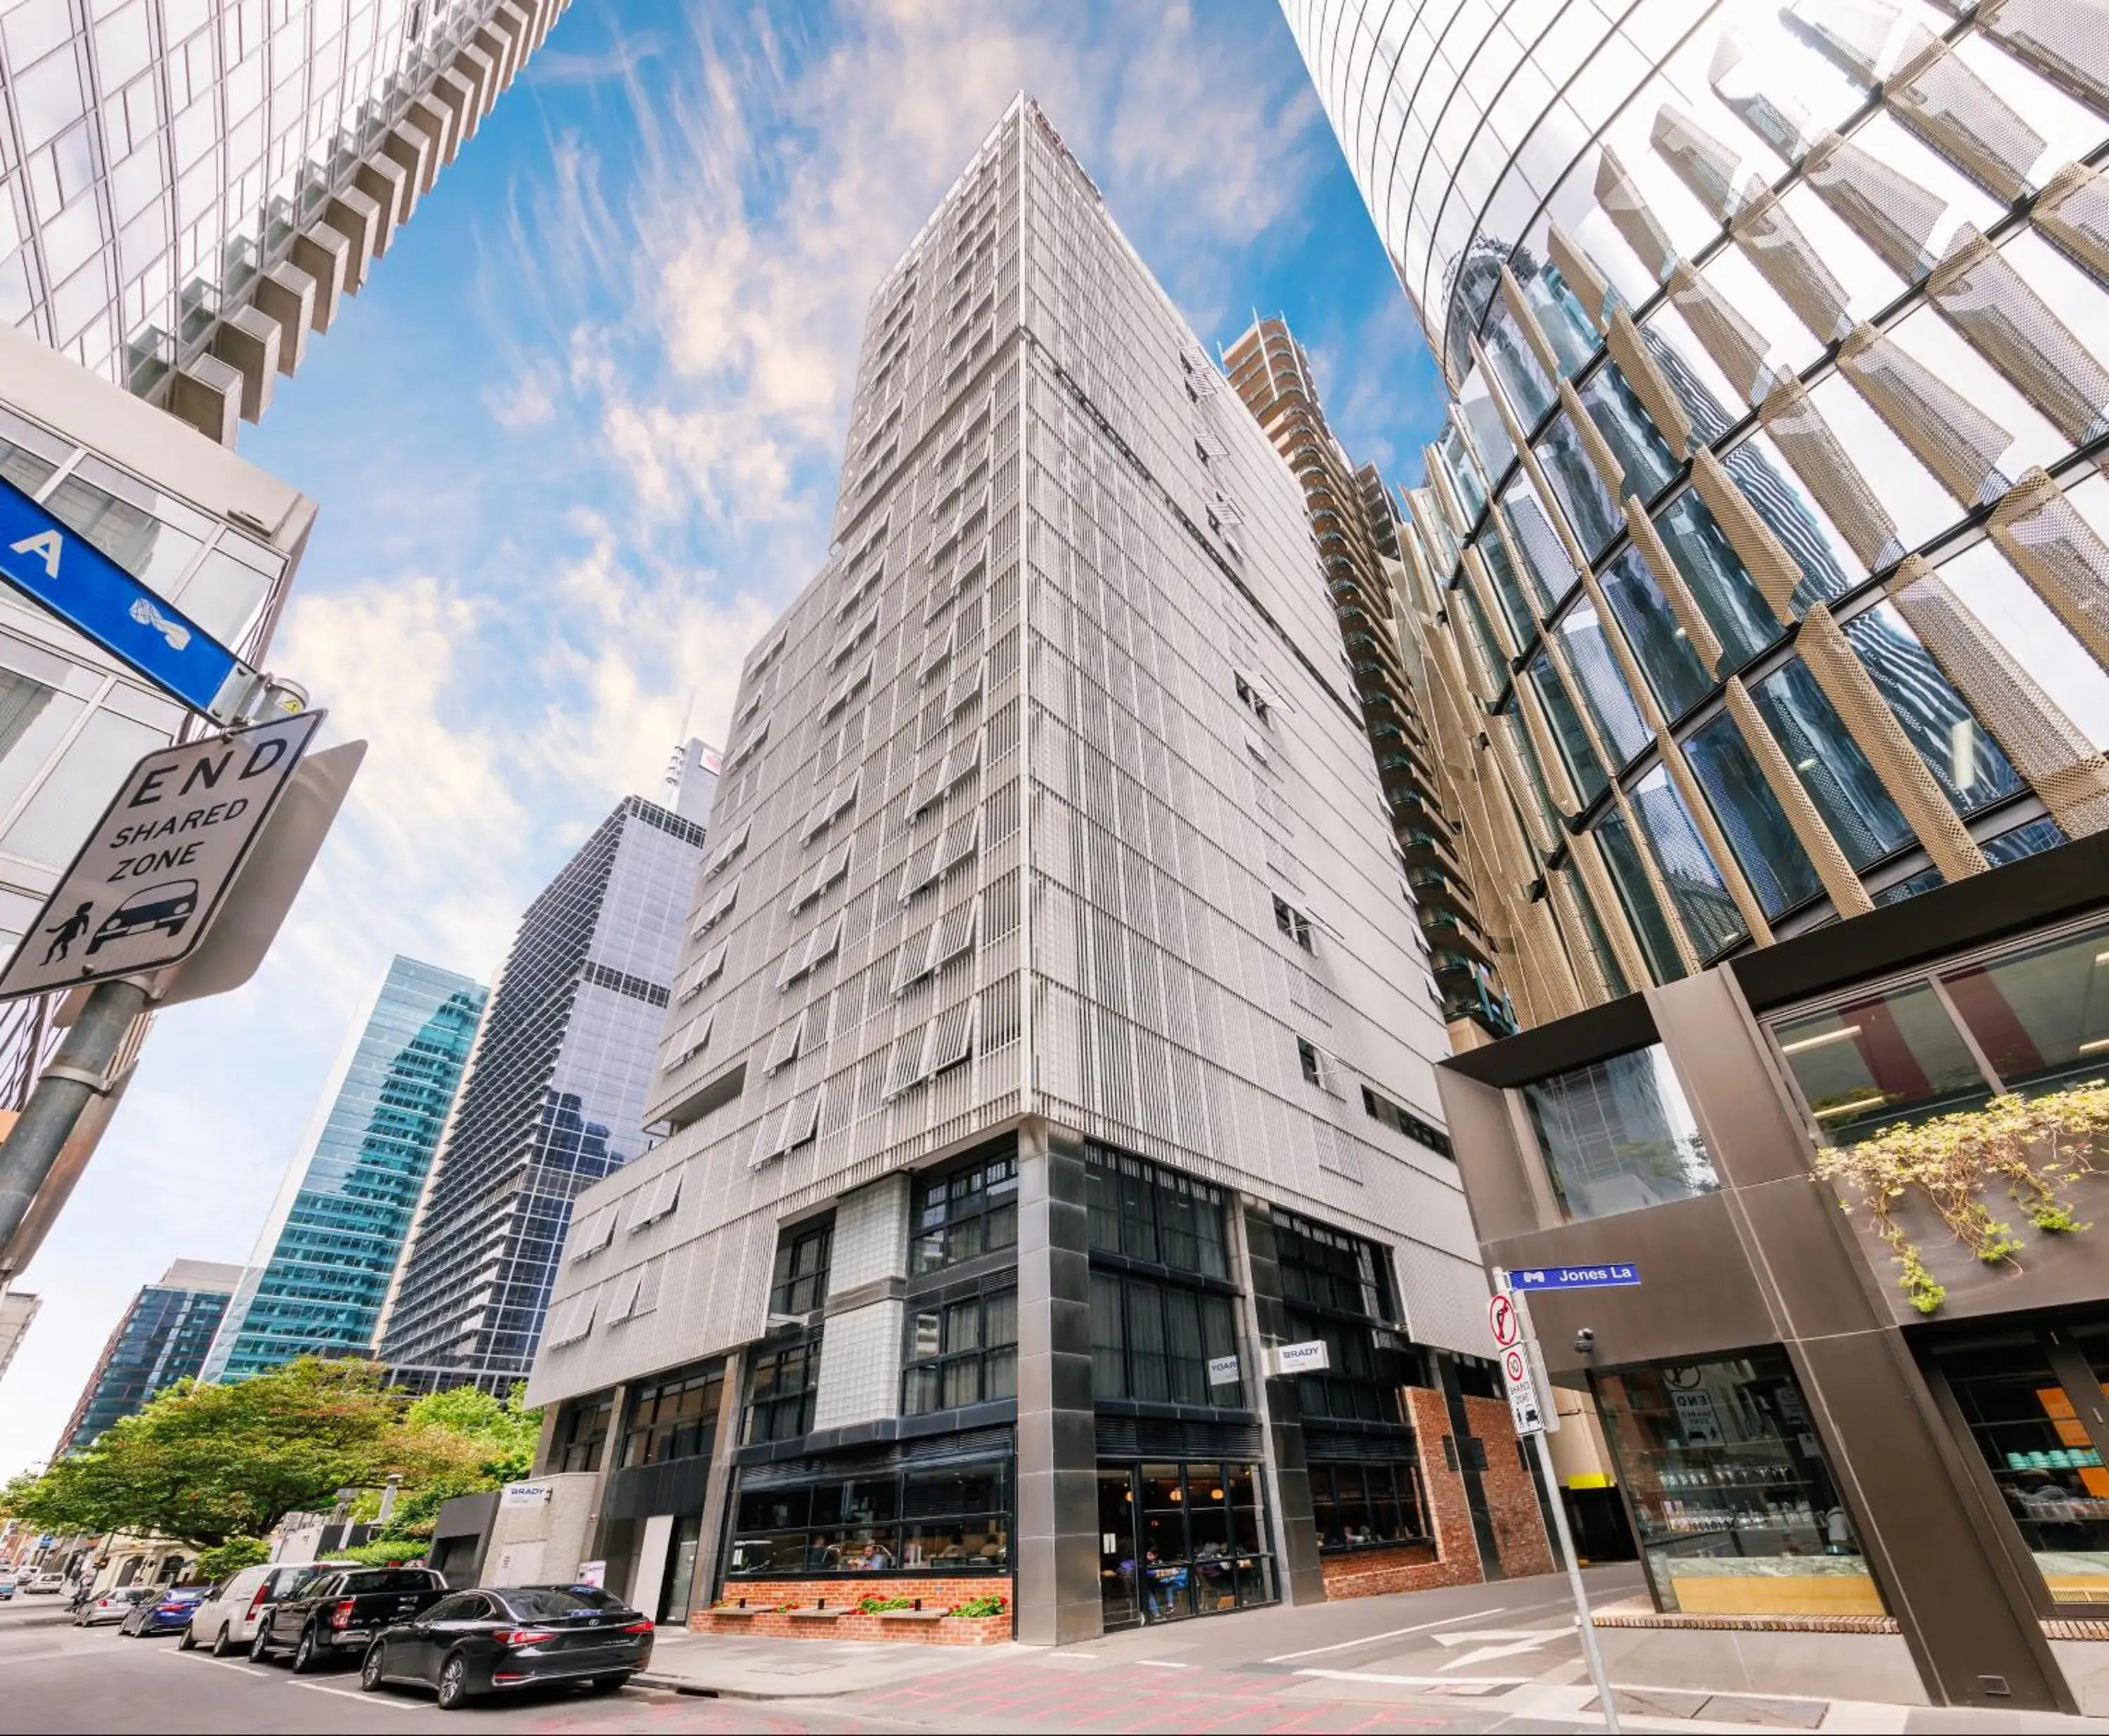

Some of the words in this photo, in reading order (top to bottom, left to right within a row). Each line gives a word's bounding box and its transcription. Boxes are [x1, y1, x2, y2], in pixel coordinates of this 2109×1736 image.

[127, 738, 288, 808] END
[110, 798, 248, 848] SHARED
[106, 841, 205, 883] ZONE
[1559, 1269, 1608, 1281] Jones
[1611, 1267, 1632, 1278] La
[1283, 1347, 1318, 1359] BRADY
